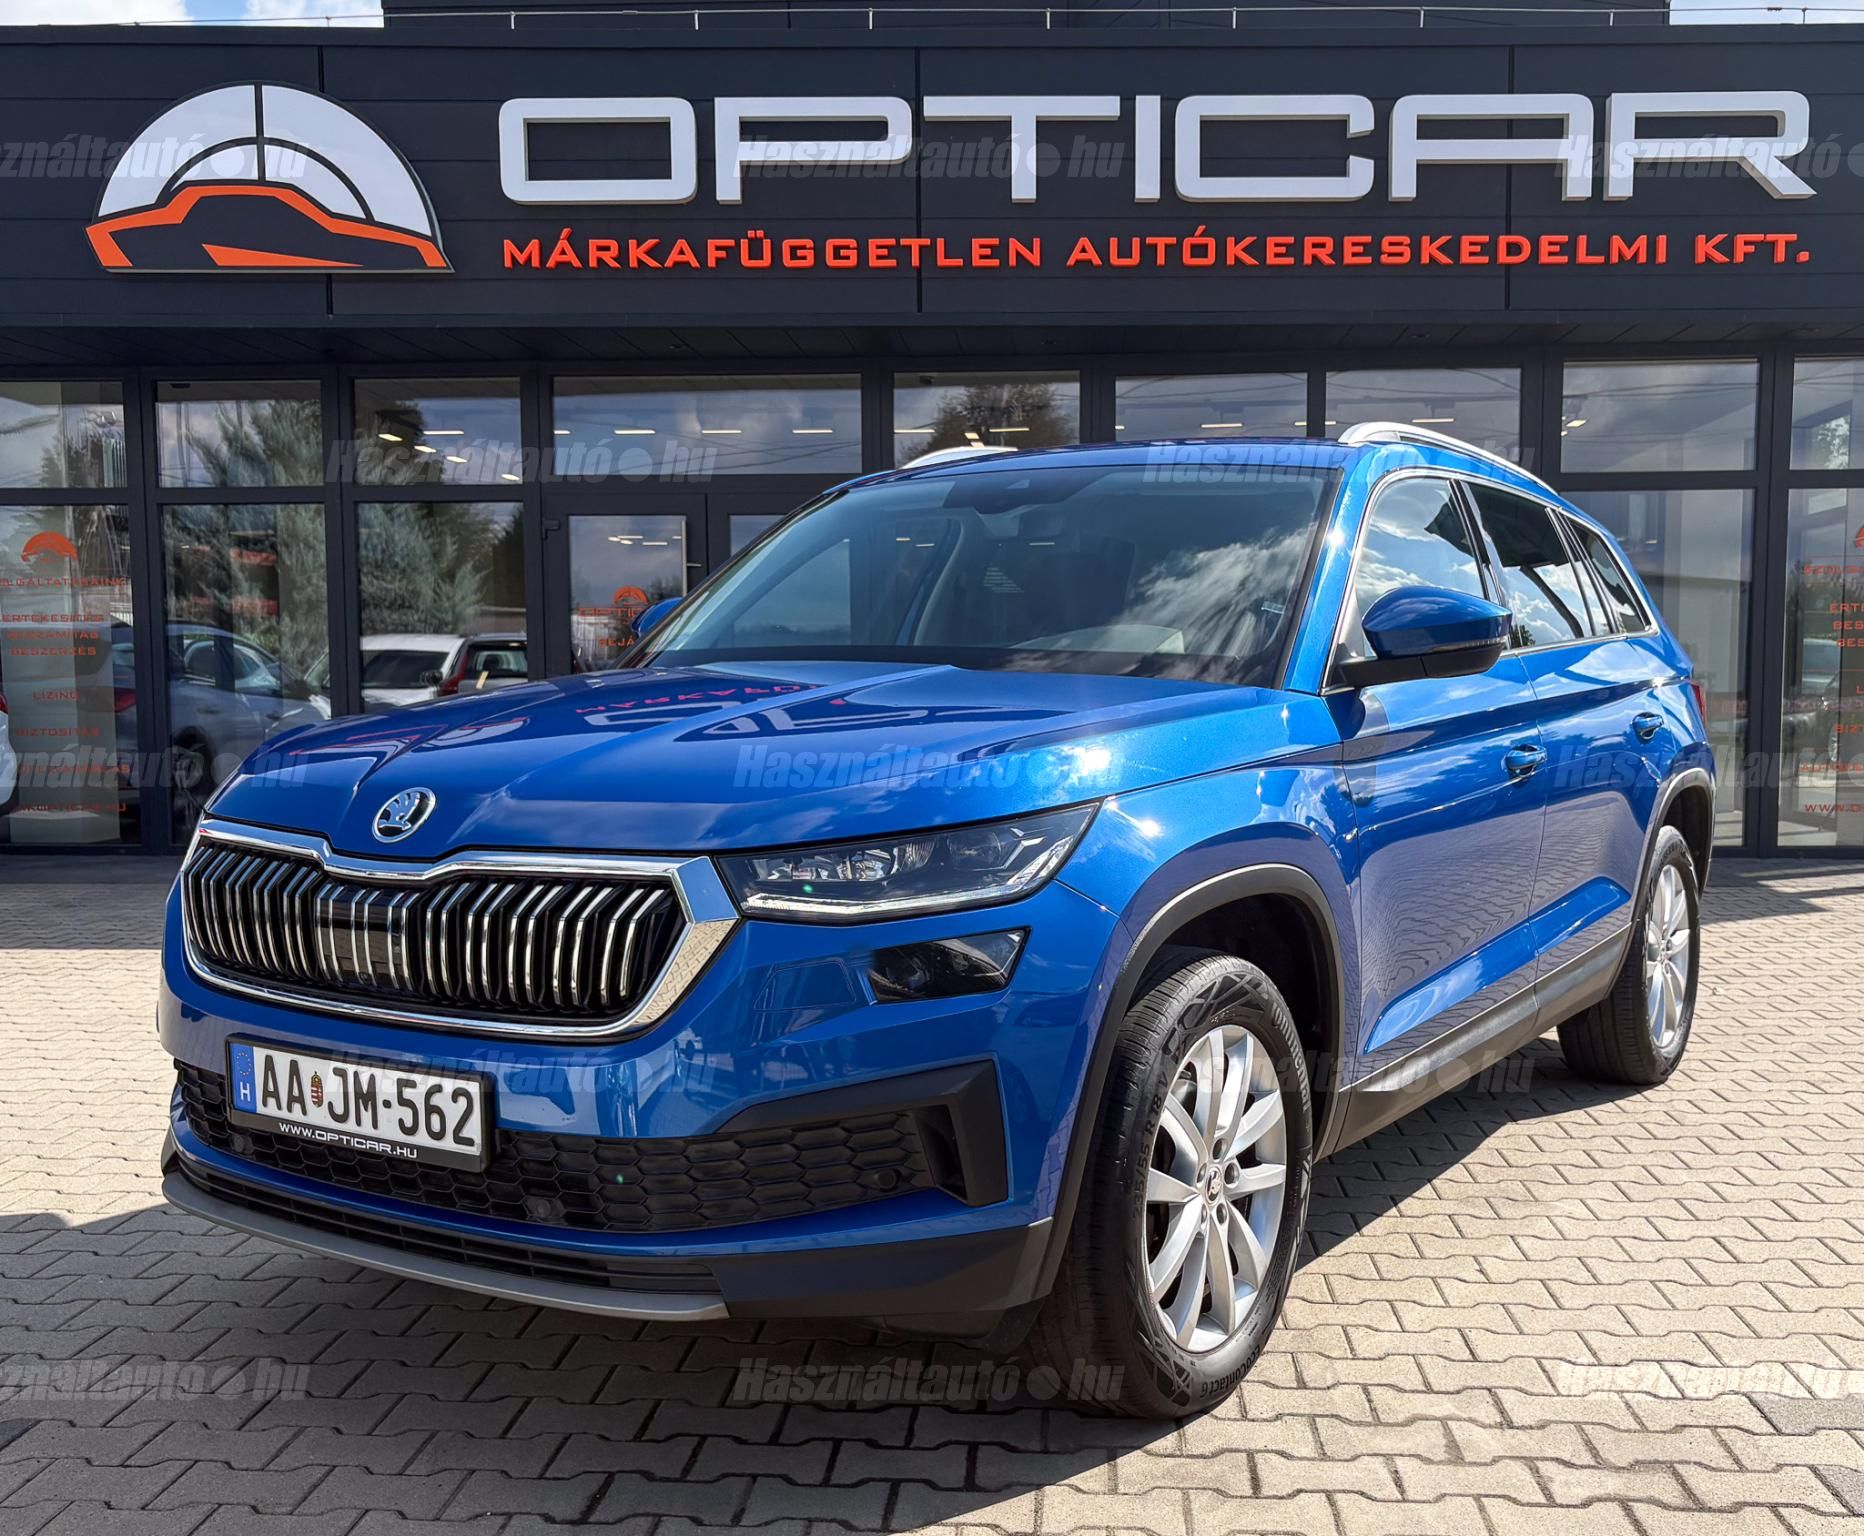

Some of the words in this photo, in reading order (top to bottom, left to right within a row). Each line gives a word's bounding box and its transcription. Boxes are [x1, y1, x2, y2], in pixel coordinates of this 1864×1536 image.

[498, 91, 1817, 205] OPTICAR
[502, 226, 1041, 269] MÁRKAFÜGGETLEN
[1066, 225, 1668, 267] AUTÓKERESKEDELMI
[1694, 233, 1811, 265] KFT.
[239, 1081, 251, 1103] H
[261, 1055, 307, 1116] AA
[278, 1122, 418, 1159] WWW.OPTICAR.HU
